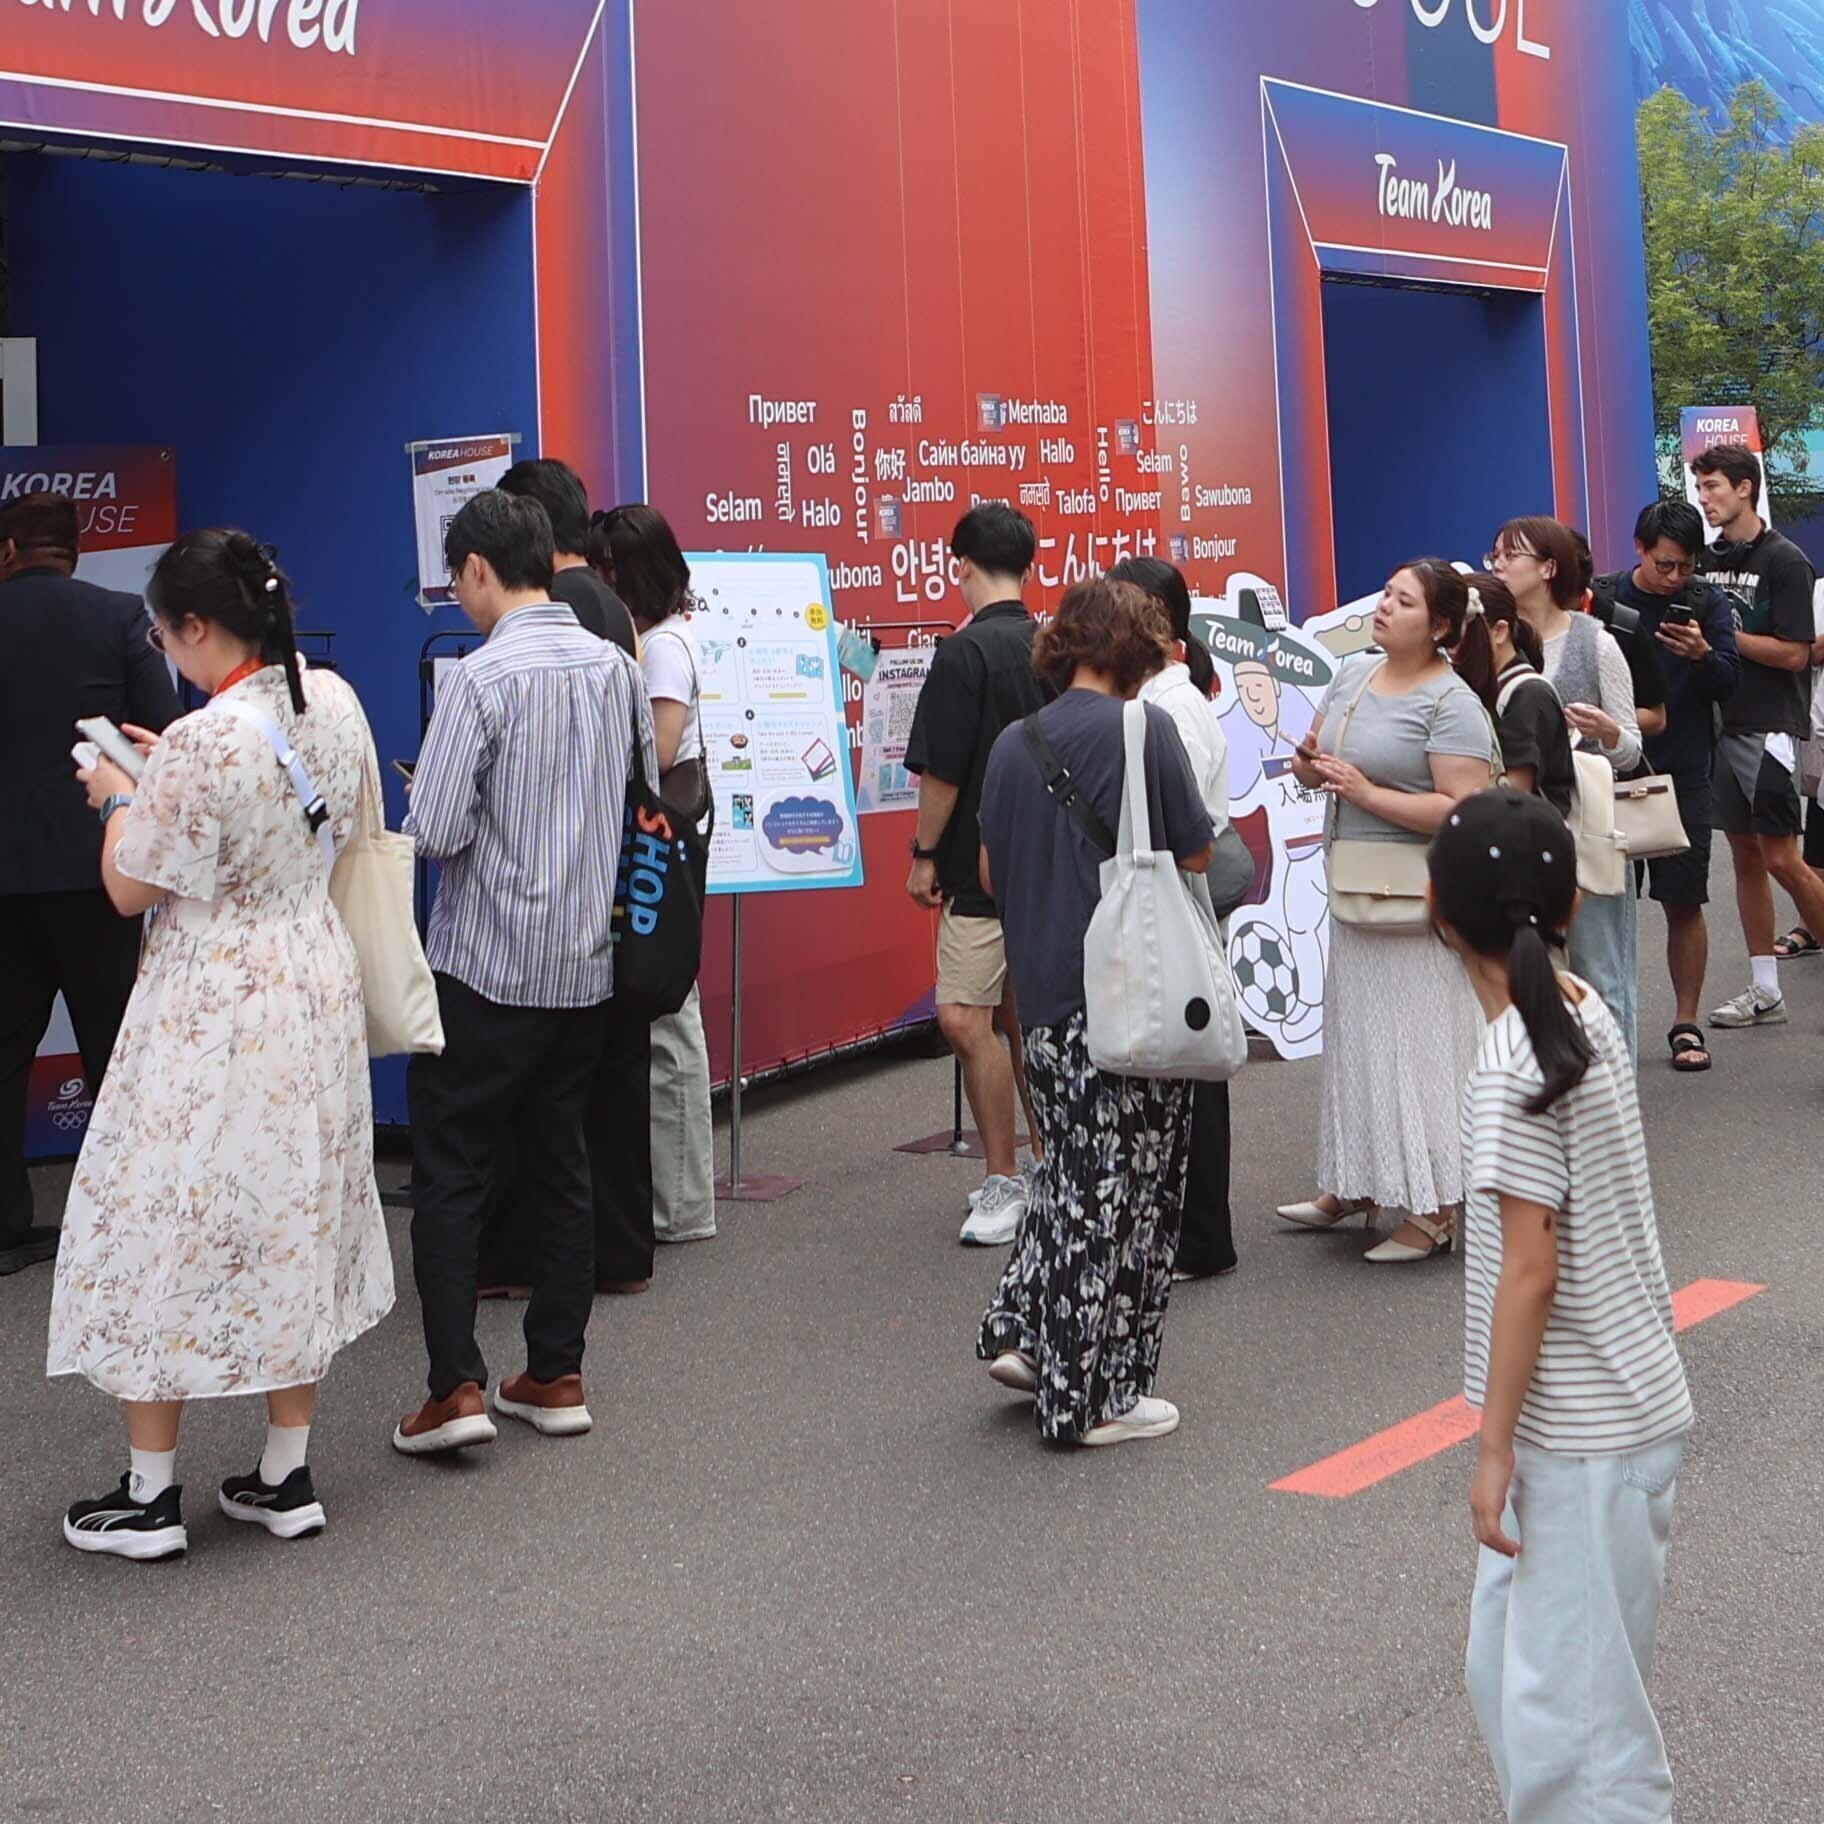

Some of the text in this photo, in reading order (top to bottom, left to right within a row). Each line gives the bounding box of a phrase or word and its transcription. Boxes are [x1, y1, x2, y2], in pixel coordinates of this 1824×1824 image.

[1375, 152, 1493, 230] Team Korea
[749, 394, 817, 430] Привет
[888, 394, 923, 424] สวัสดี
[1008, 398, 1068, 425] Merhaba
[1142, 399, 1198, 425] こんにちは
[1696, 418, 1739, 433] KOREA
[428, 445, 494, 461] KOREA HOUSE
[807, 442, 836, 474] Olá
[874, 447, 907, 481] 你好
[919, 438, 1027, 471] Сайн байна уу
[1039, 436, 1075, 464] Hallo
[1097, 426, 1112, 503] Hello
[1136, 447, 1173, 474] Selam
[0, 471, 118, 500] KOREA
[851, 408, 869, 545] Bonjour
[902, 476, 955, 503] Jambo
[1179, 443, 1192, 522] Bawo
[706, 490, 763, 523] Selam
[1055, 487, 1097, 515] Talofa
[1115, 489, 1163, 516] Привет
[1194, 484, 1252, 508] Sawubona
[801, 497, 841, 528] Halo
[1192, 534, 1237, 563] Bonjour
[828, 561, 882, 590] ubona
[1205, 619, 1314, 677] Team Korea
[626, 804, 674, 937] SHOP
